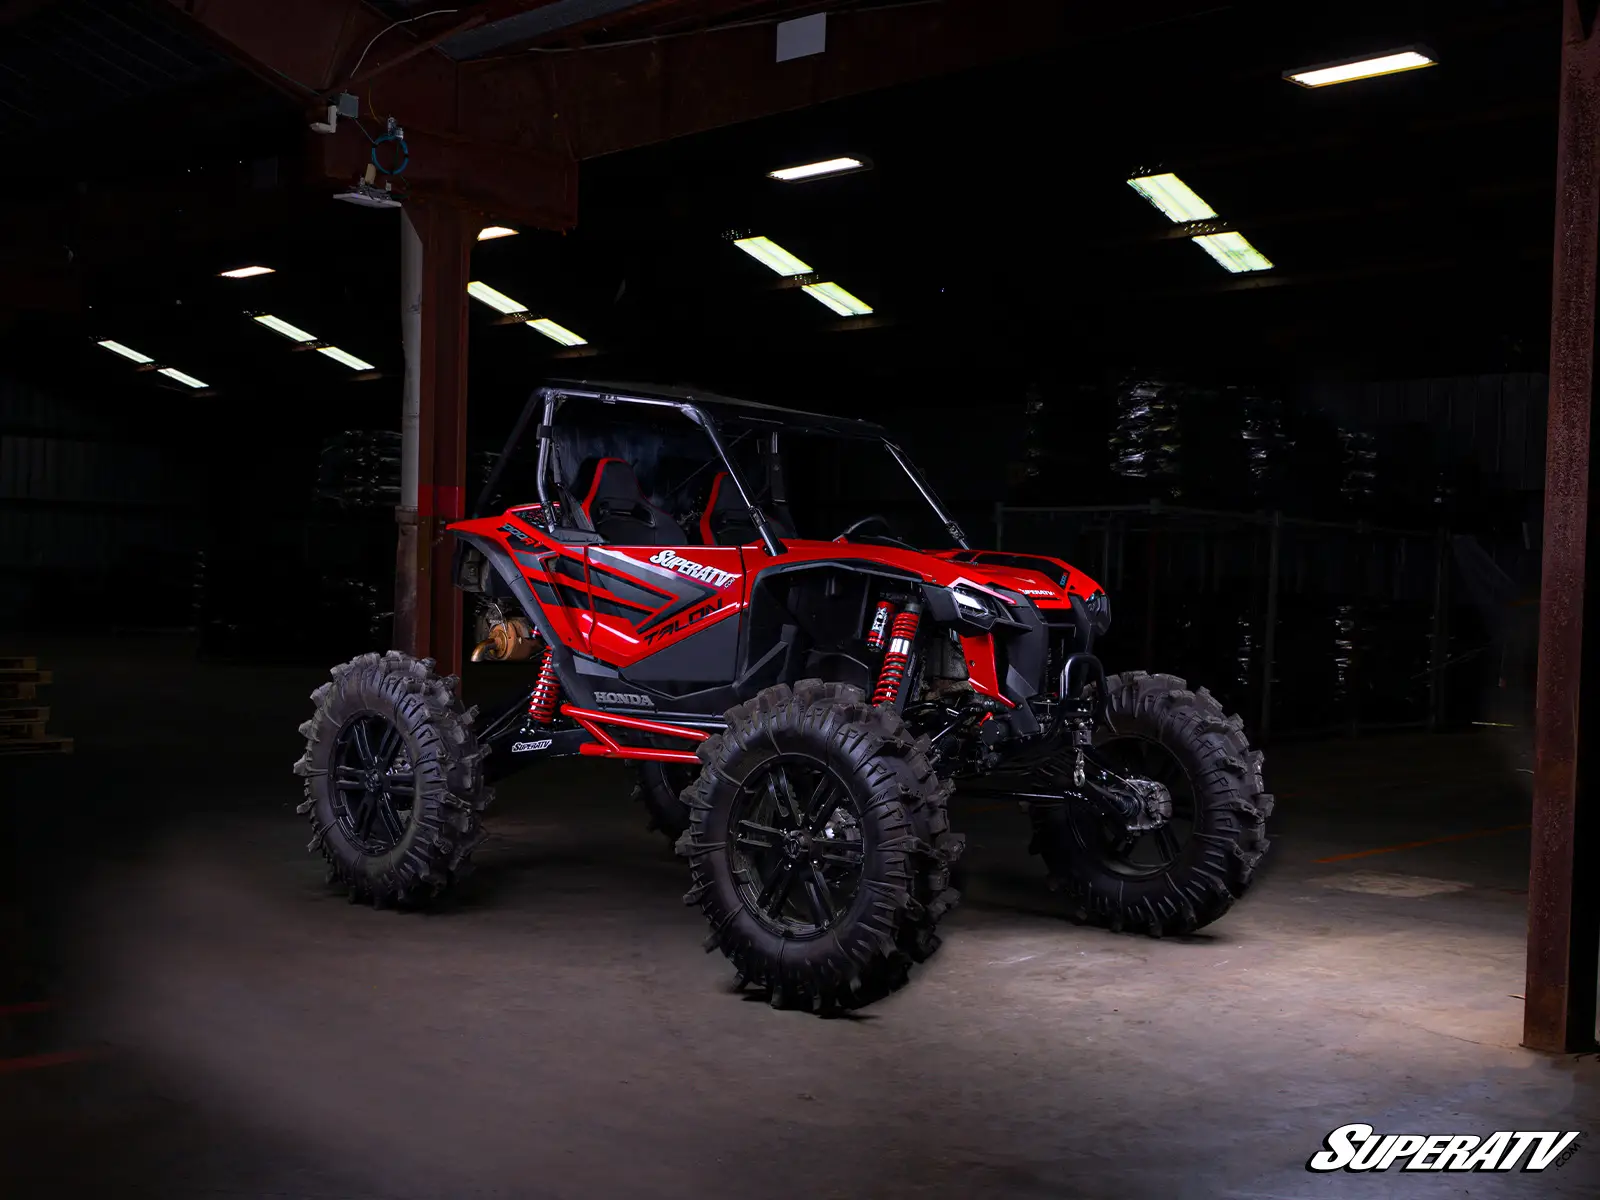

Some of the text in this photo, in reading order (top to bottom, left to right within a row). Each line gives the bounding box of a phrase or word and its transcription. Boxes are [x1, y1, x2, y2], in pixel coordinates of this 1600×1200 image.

[649, 550, 742, 587] SUPERATV
[643, 598, 722, 646] TALON
[594, 691, 655, 706] HONDA
[512, 741, 551, 751] SUPERATV
